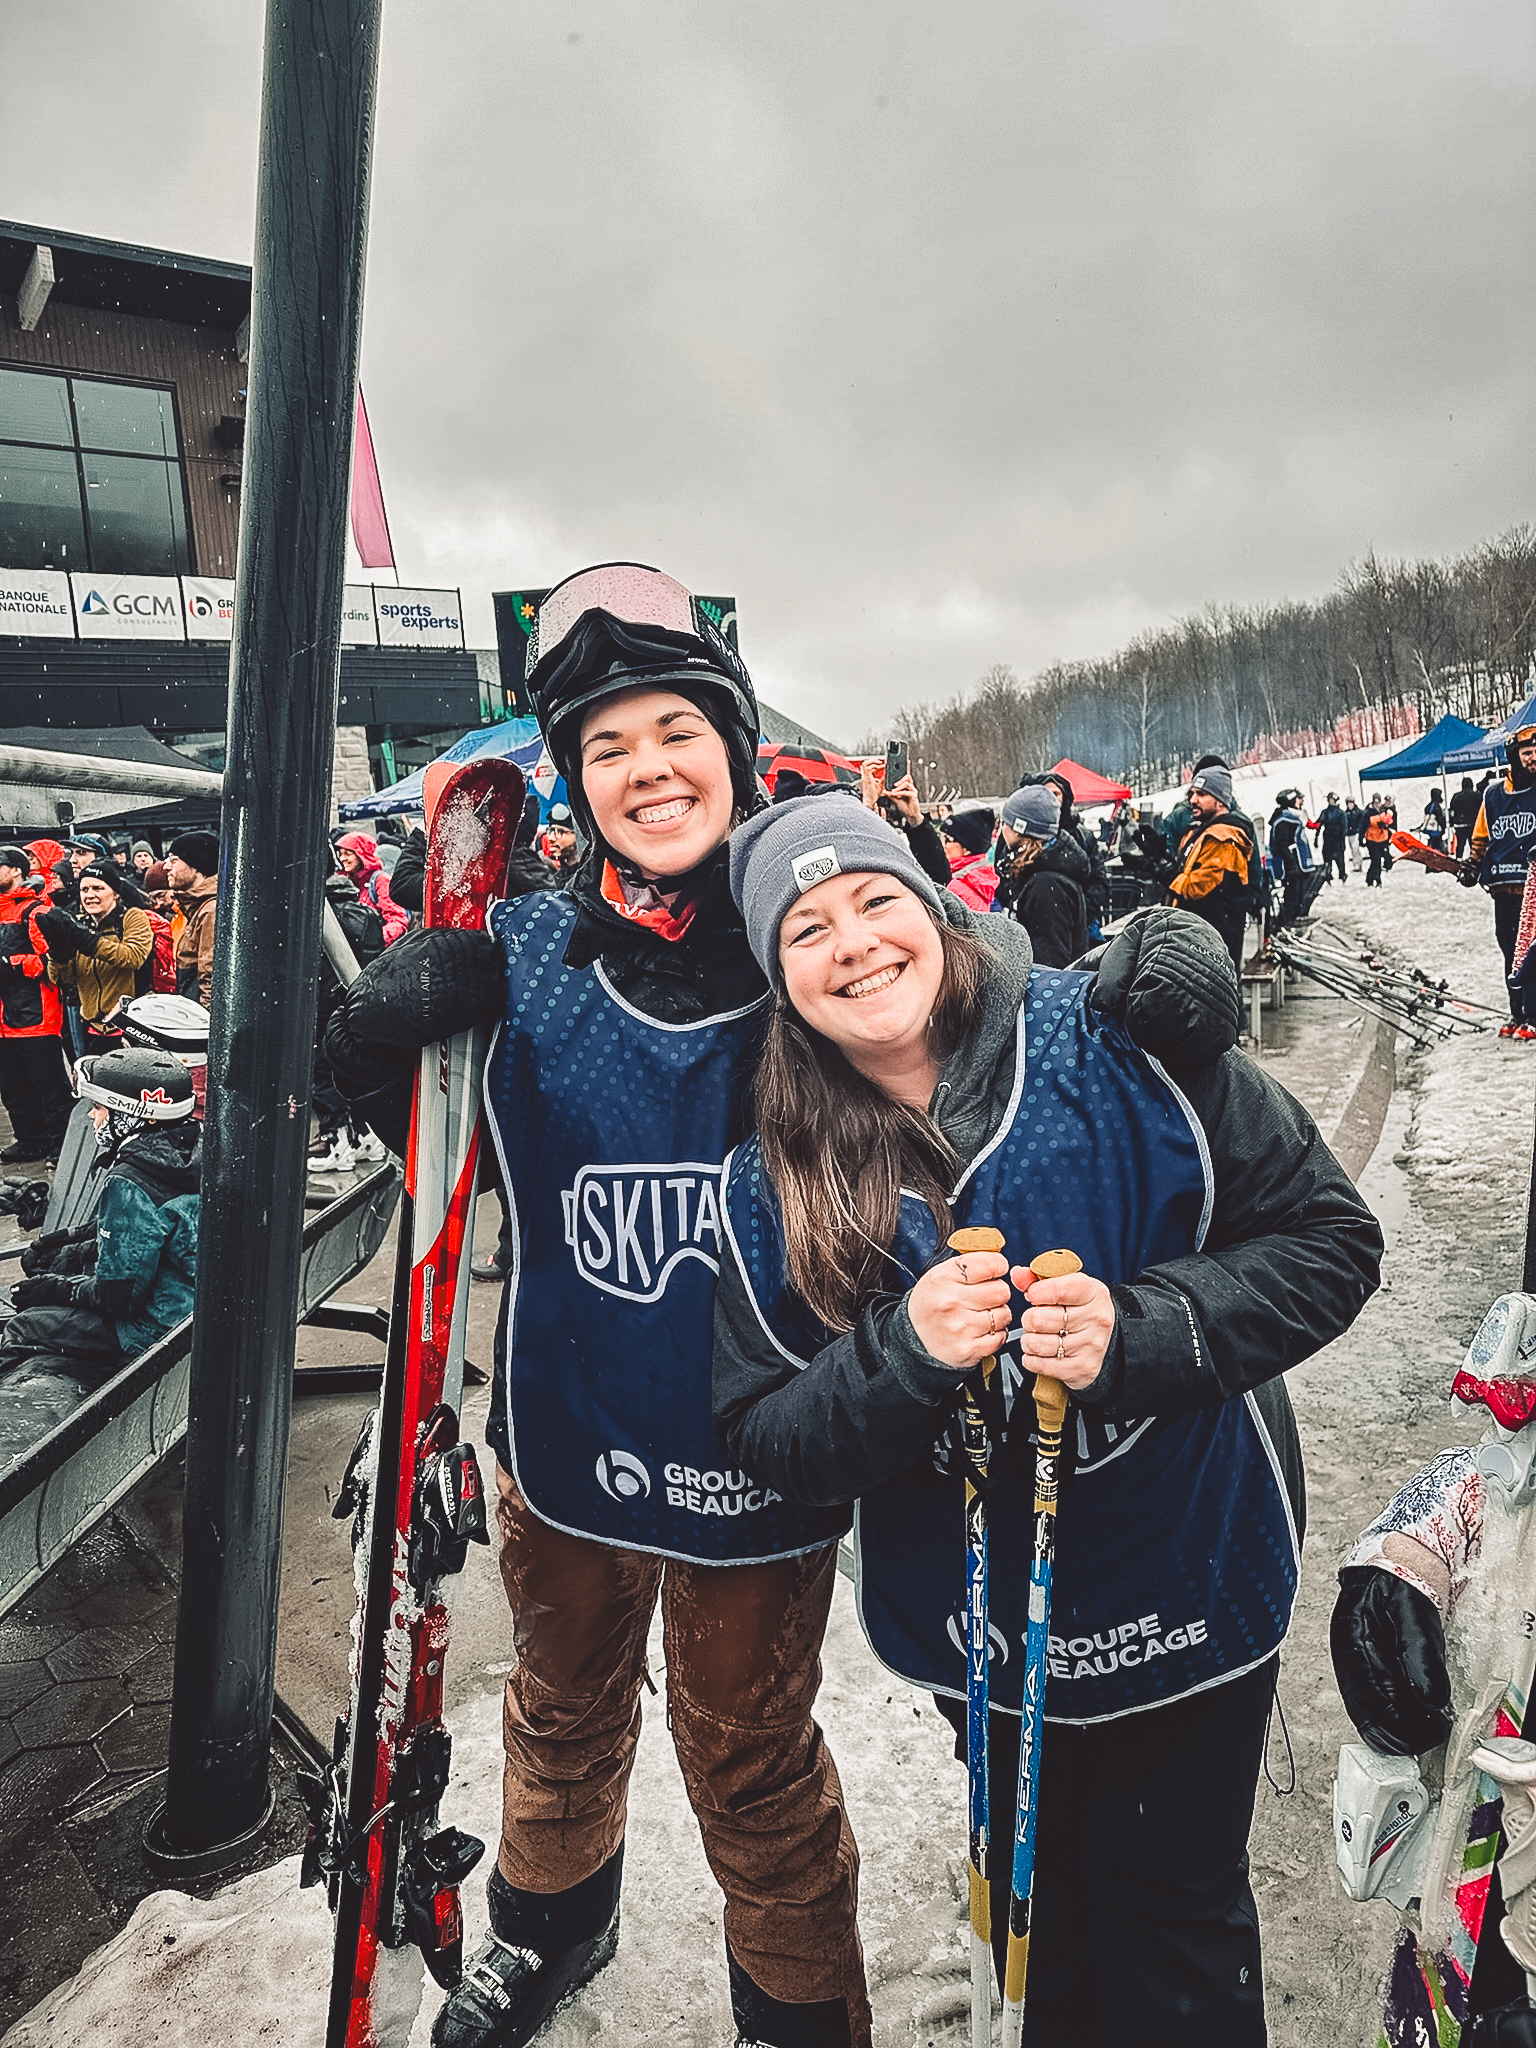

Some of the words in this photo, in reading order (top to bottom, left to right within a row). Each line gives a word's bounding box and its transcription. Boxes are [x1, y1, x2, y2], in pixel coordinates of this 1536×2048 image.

[0, 590, 49, 602] BANQUE
[113, 594, 176, 616] GCM
[0, 602, 67, 614] NATIONALE
[380, 604, 432, 618] sports
[401, 616, 459, 631] experts
[972, 1500, 985, 1682] KERMA
[1021, 1613, 1161, 1658] ROUPE
[1046, 1619, 1208, 1680] EAUCAGE
[1017, 1664, 1038, 1844] KERMA
